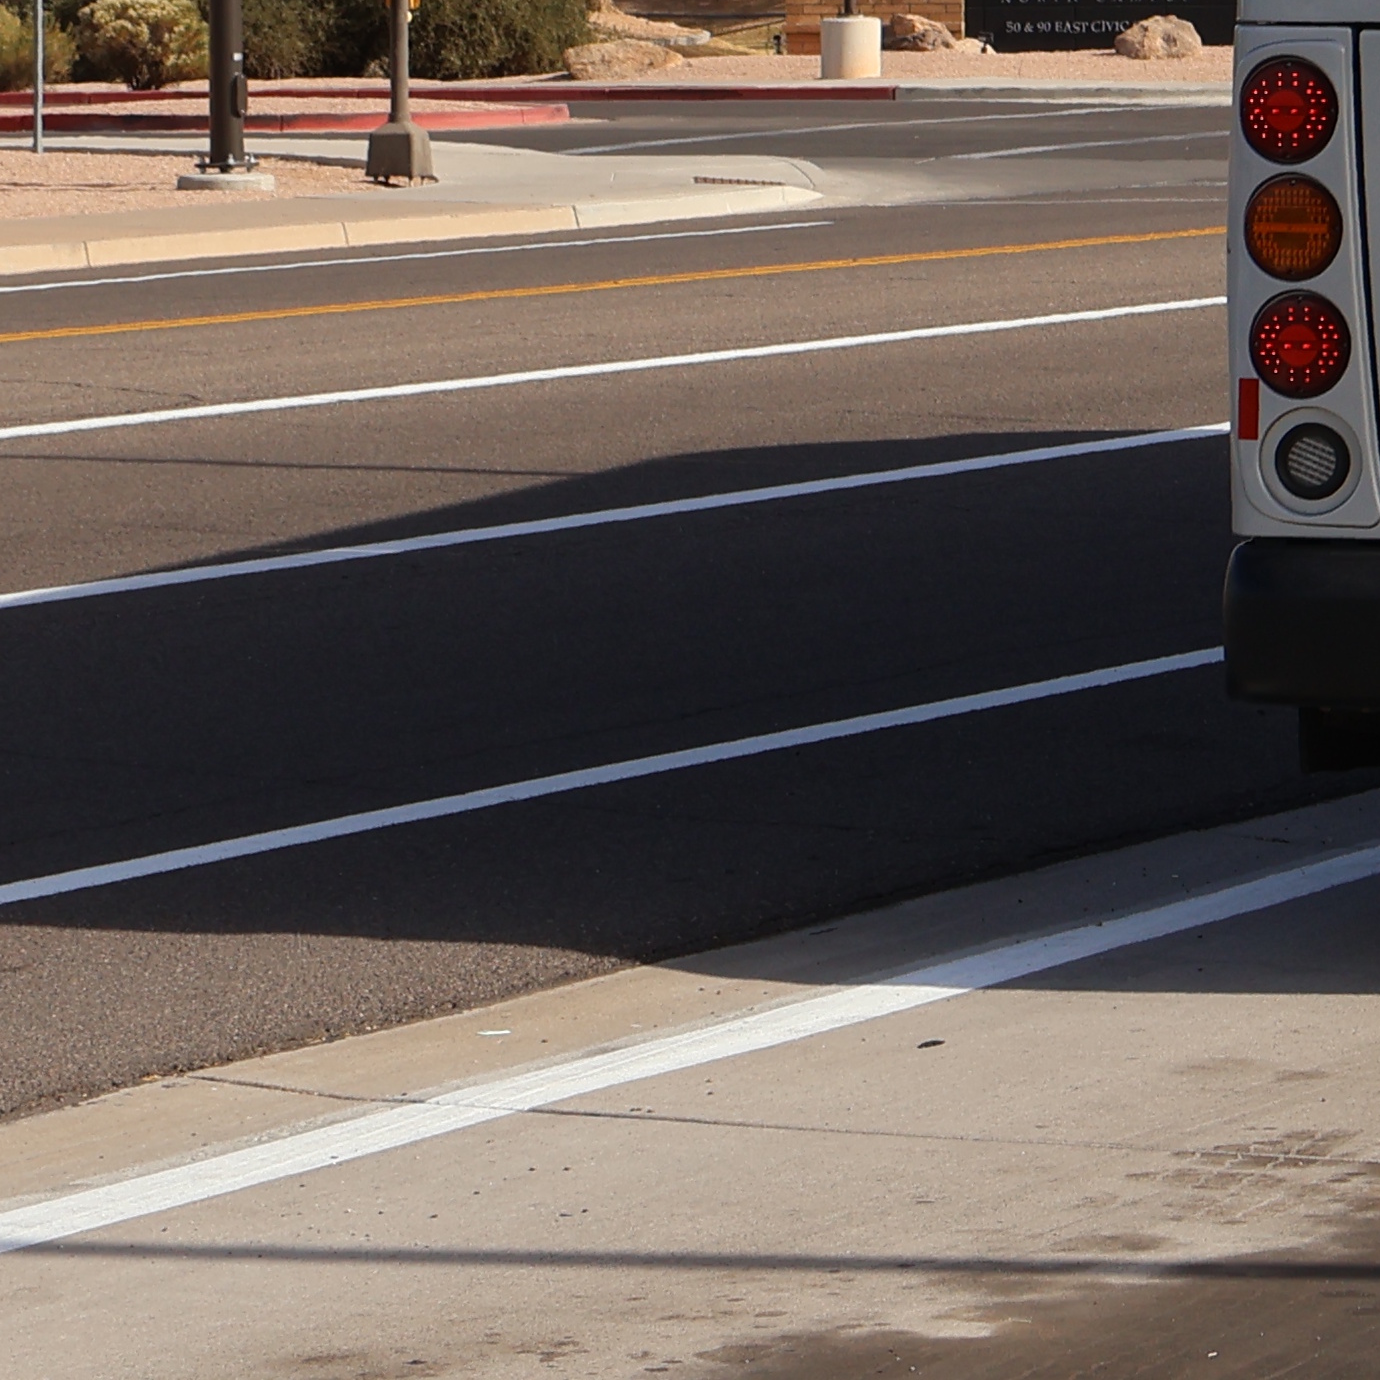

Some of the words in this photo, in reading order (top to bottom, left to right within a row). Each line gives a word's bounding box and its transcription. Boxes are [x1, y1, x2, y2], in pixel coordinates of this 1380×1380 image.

[1006, 21, 1021, 33] 50
[1036, 21, 1051, 32] 90
[1055, 20, 1089, 33] EAST
